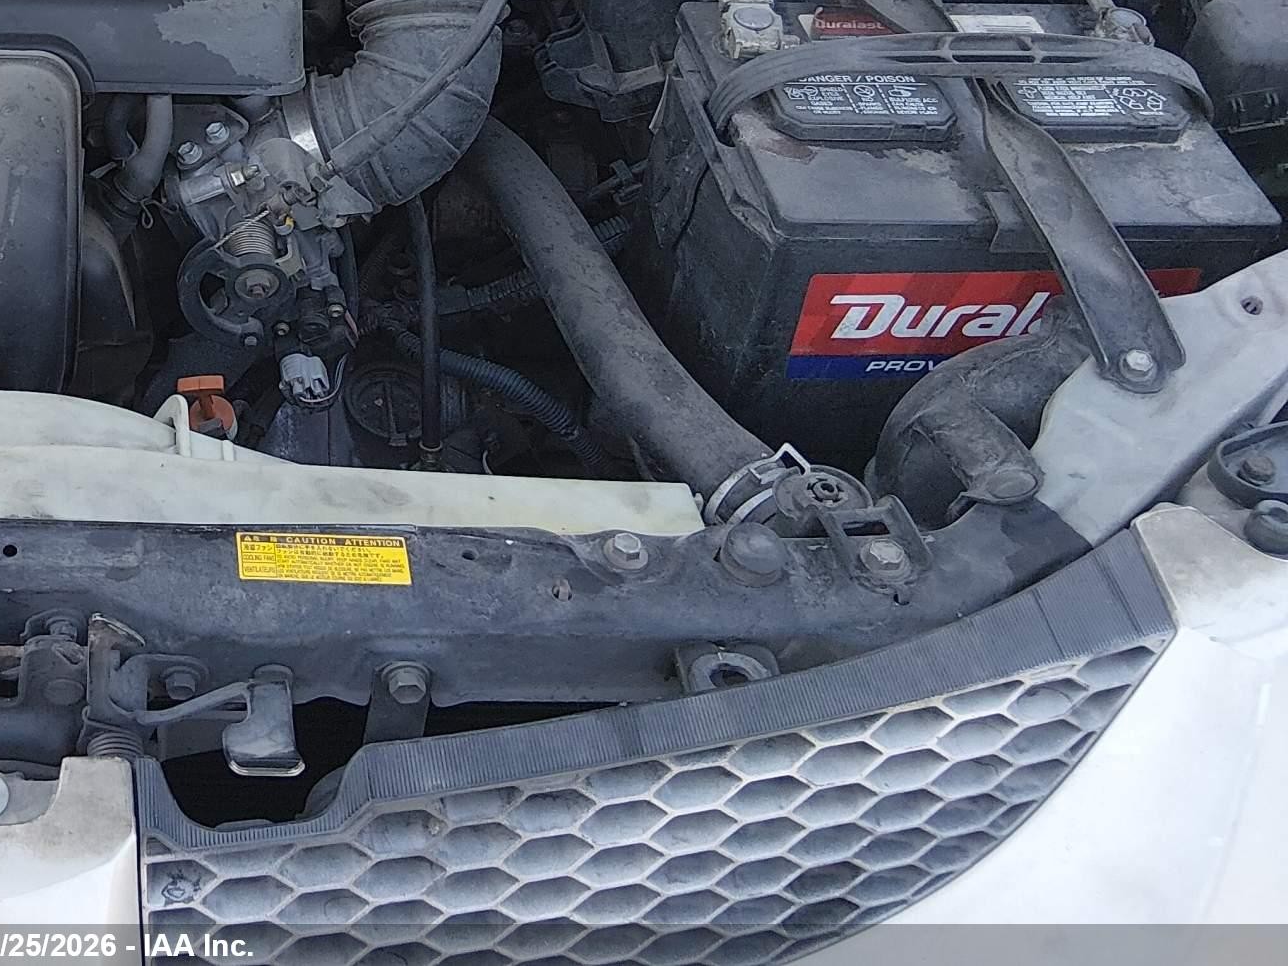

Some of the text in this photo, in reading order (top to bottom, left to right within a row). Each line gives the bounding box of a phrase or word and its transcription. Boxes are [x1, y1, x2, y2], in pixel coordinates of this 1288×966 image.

[815, 19, 886, 31] Duralast
[866, 75, 916, 83] POISON
[286, 536, 337, 545] CAUTION
[345, 538, 401, 547] ATTENTION
